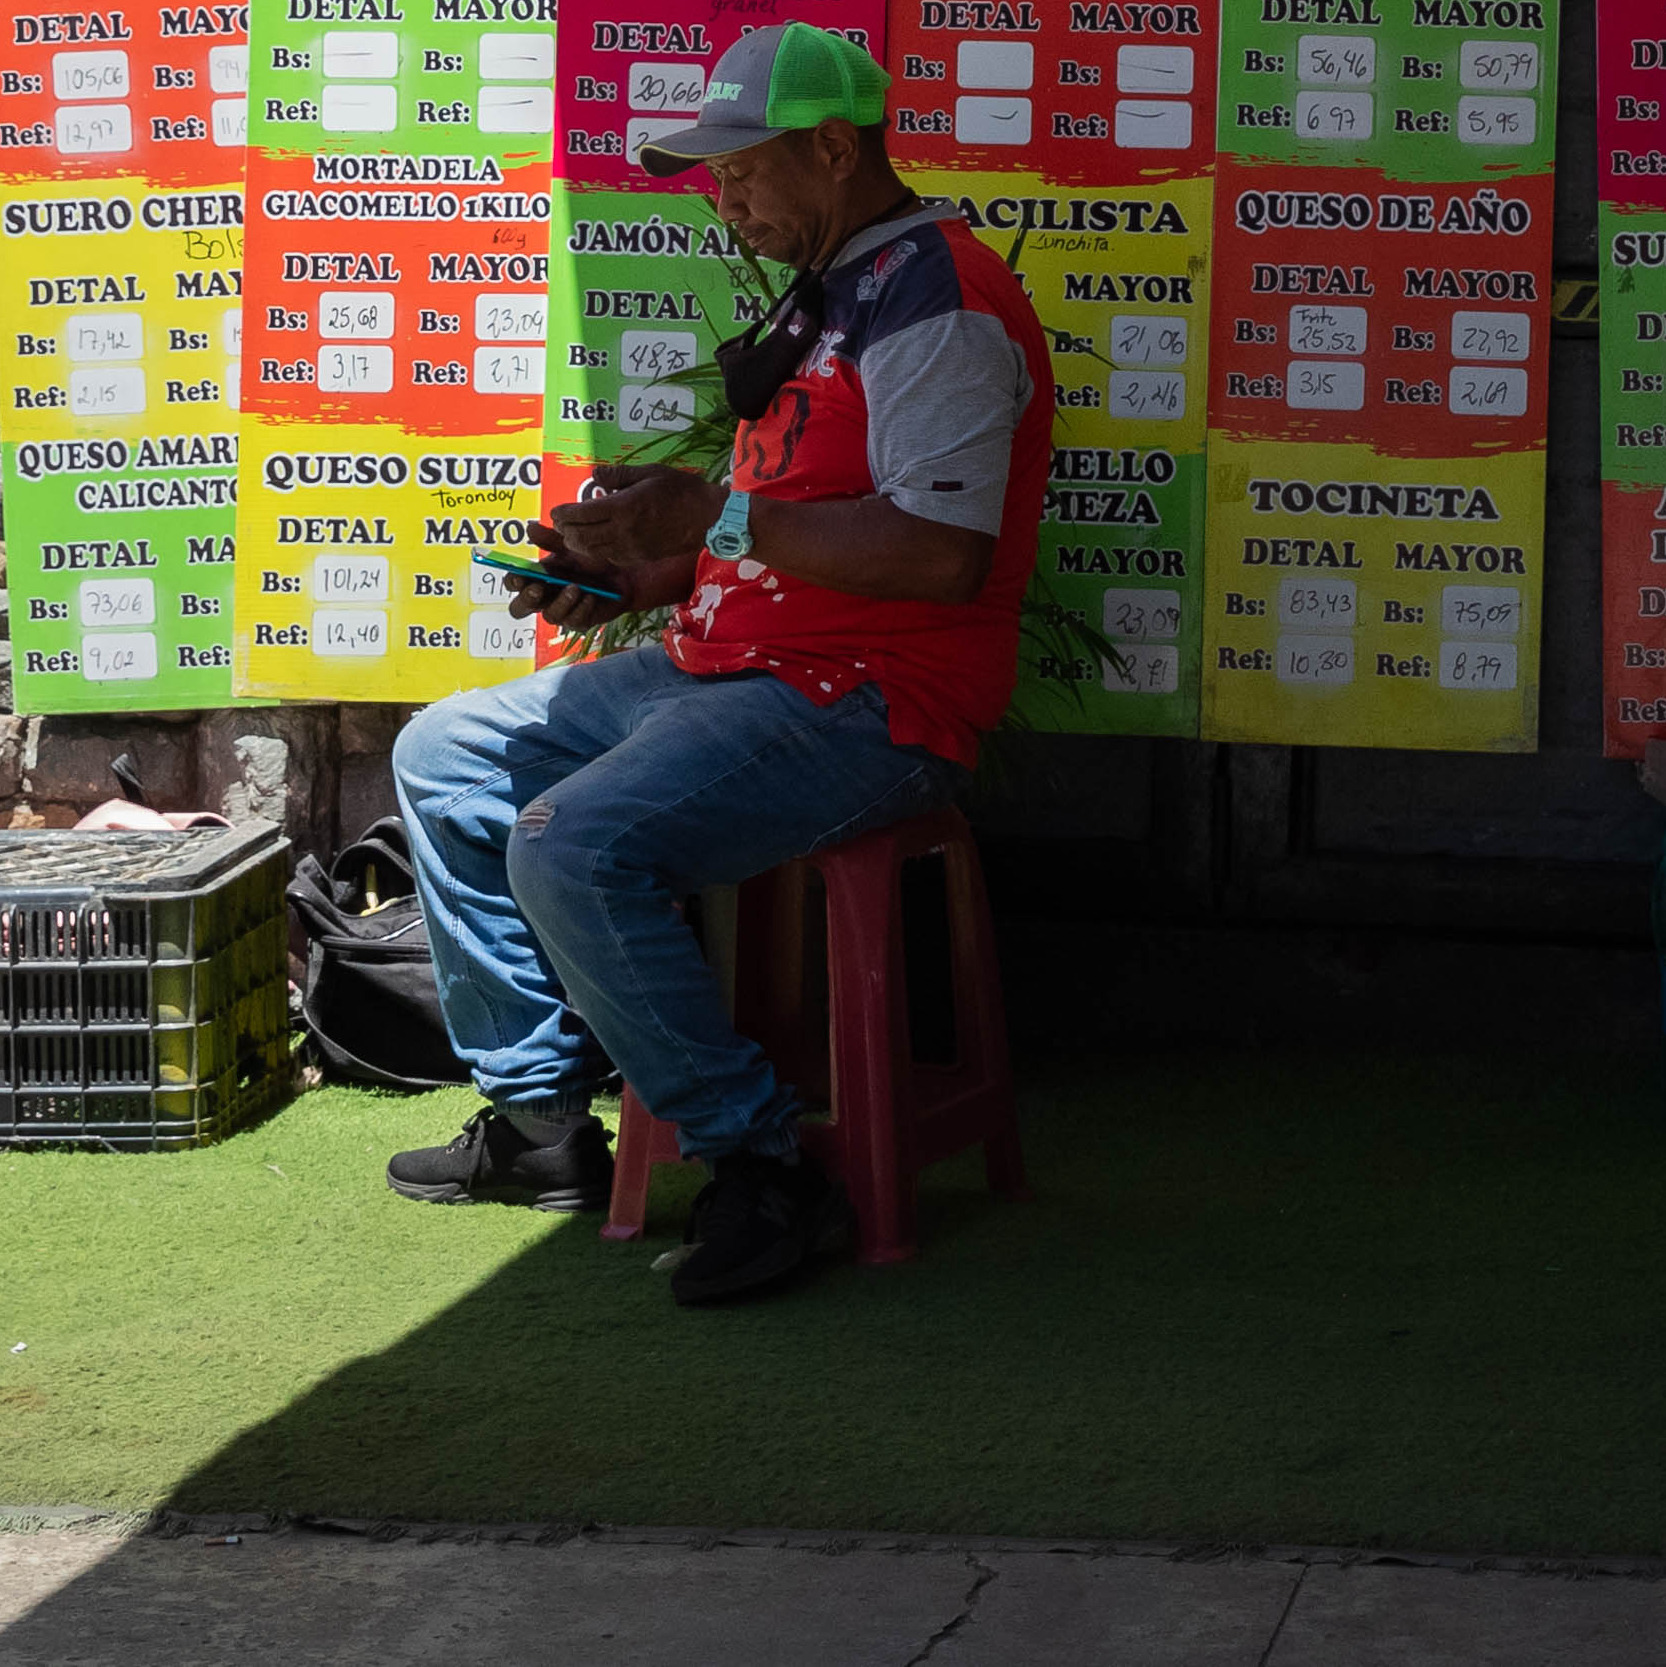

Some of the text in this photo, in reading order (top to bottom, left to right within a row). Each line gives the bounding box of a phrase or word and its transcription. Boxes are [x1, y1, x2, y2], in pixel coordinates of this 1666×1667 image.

[313, 158, 501, 183] MORTADELA
[5, 198, 130, 235] SUERO
[263, 193, 550, 219] GIACOMELLO 1KILO
[1235, 189, 1530, 236] QUESO DE AÑO
[568, 217, 691, 255] JAMÓN
[18, 443, 128, 479] QUESO
[264, 456, 542, 490] QUESO SUIZO
[1250, 479, 1500, 522] TOCINETA
[278, 518, 394, 545] DETAL
